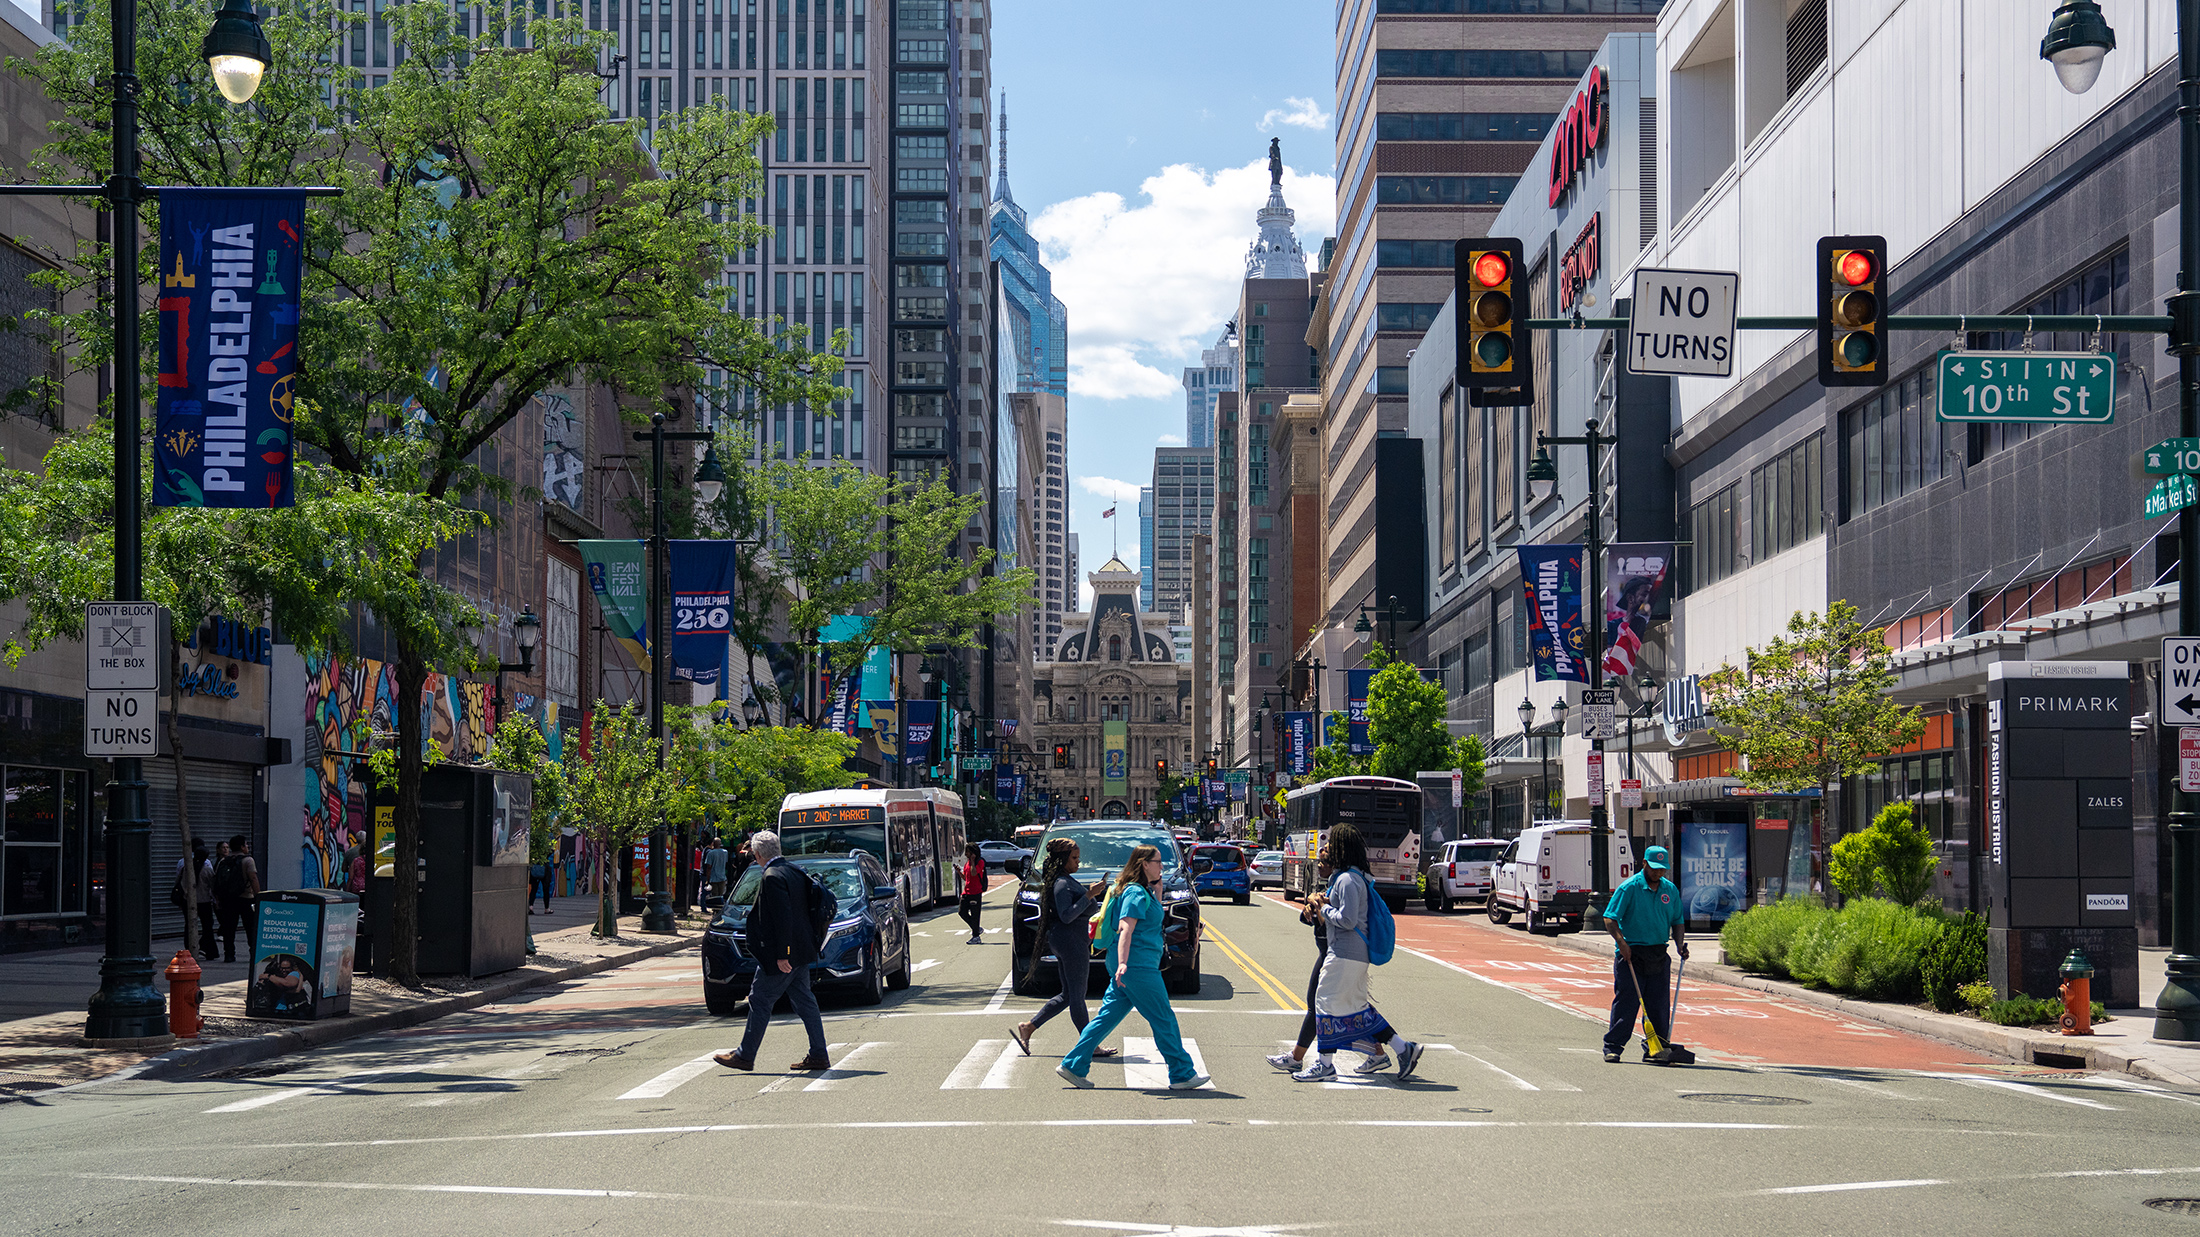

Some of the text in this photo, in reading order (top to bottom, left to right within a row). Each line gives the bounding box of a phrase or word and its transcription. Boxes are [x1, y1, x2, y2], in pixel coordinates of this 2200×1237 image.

[1659, 285, 1710, 318] NO
[1636, 332, 1728, 362] TURNS
[203, 222, 254, 492] PHILADELPHIA
[1980, 360, 1993, 379] S
[2060, 361, 2076, 380] N
[1962, 384, 2090, 415] 10th St
[2183, 440, 2190, 448] S
[2152, 483, 2196, 514] Market St
[616, 562, 640, 573] FAN
[612, 573, 640, 585] FEST
[675, 595, 730, 607] PHILADELPHIA
[122, 606, 153, 616] BLOCK
[676, 607, 729, 630] 250
[1516, 605, 1524, 653] PRIMARK
[216, 615, 272, 665] BLUE
[100, 658, 145, 668] THE BOX
[2044, 665, 2070, 675] FASHION
[202, 663, 239, 699] Blue
[1666, 674, 1698, 723] ULTA
[2019, 697, 2119, 712] PRIMARK
[106, 698, 138, 717] NO
[1351, 708, 1370, 721] 25
[91, 728, 152, 744] TURNS
[909, 731, 931, 742] 250
[1294, 718, 1304, 773] PHILADELPHIA
[2181, 749, 2200, 757] STOP
[2190, 761, 2200, 770] BU
[1991, 734, 2001, 865] FASHION DISTRICT
[2088, 797, 2123, 807] ZALES
[797, 811, 807, 823] 17
[814, 810, 830, 822] 2ND
[840, 808, 870, 821] MARKET
[1704, 843, 1727, 858] LET
[1686, 858, 1744, 872] THERE BE
[1695, 872, 1735, 887] GOALS
